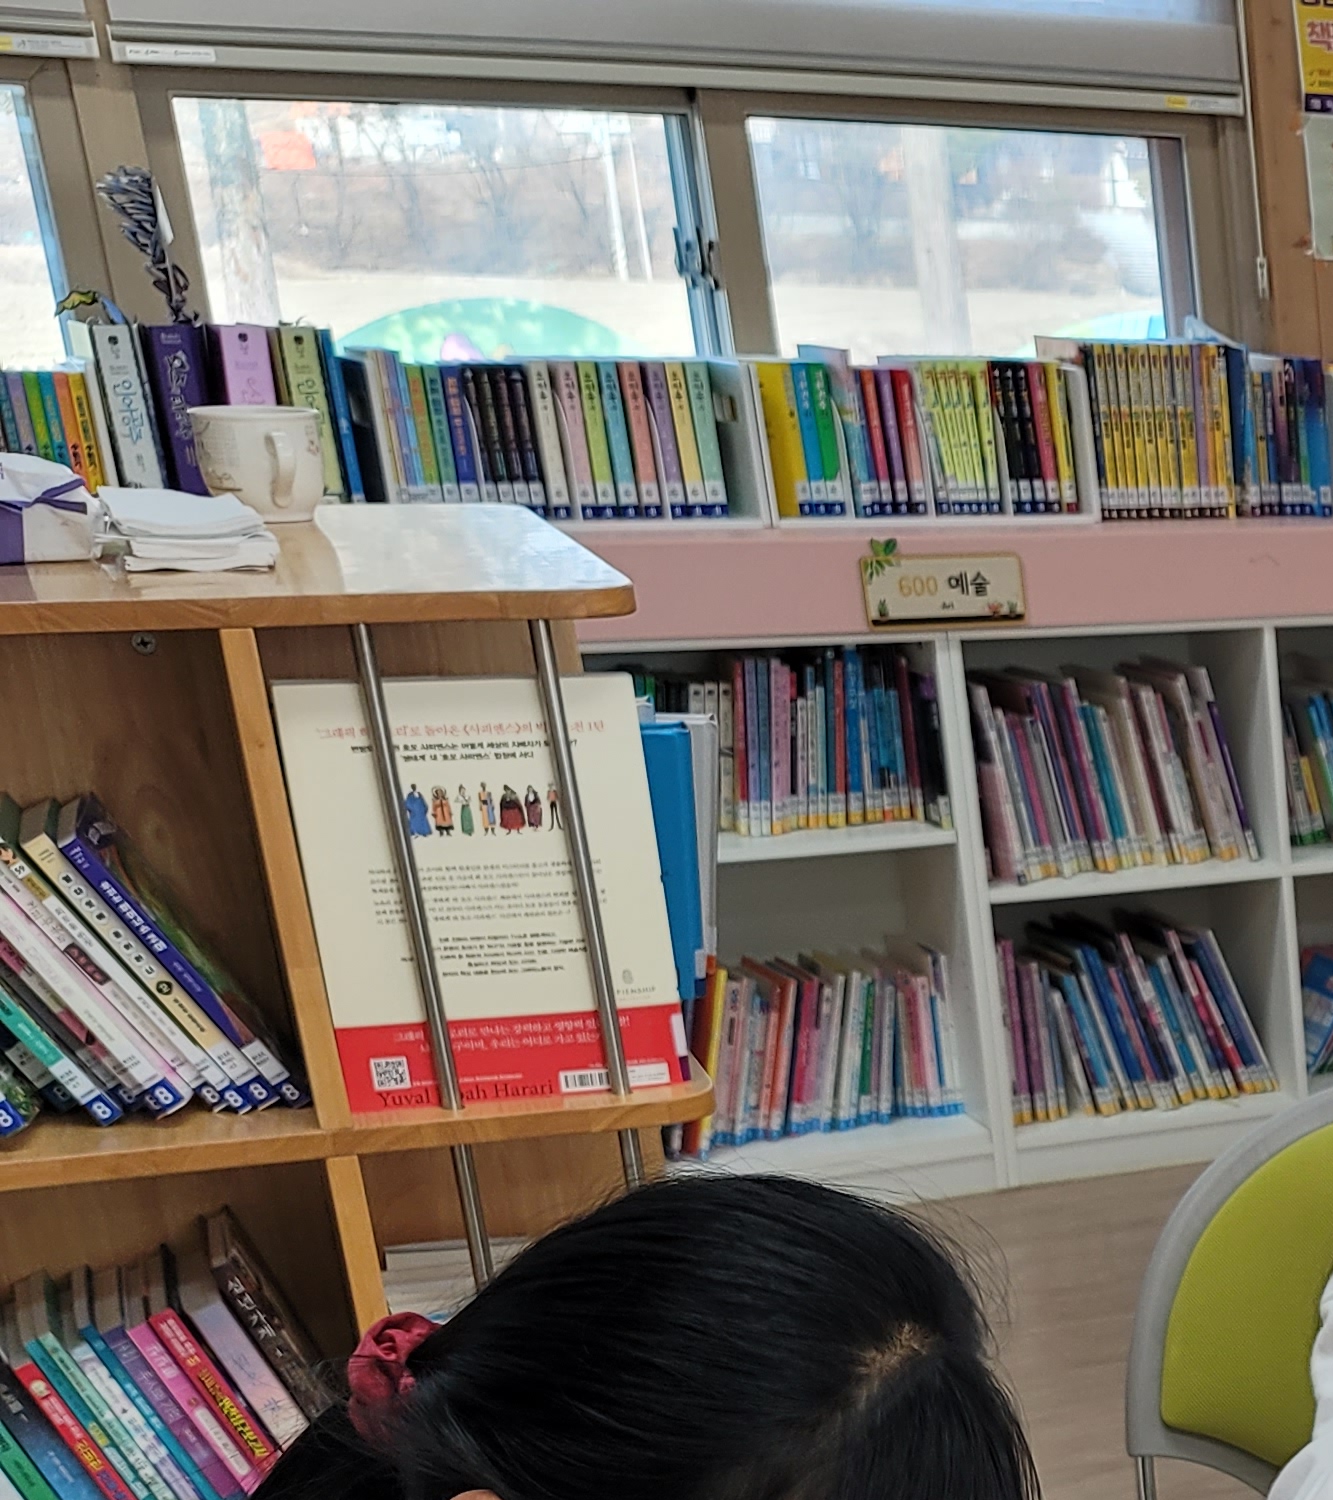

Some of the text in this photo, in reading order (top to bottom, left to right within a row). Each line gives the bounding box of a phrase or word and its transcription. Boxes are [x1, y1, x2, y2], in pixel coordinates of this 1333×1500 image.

[898, 571, 990, 597] 600 예술
[378, 1090, 432, 1108] Yuval
[494, 1079, 554, 1100] Harari
